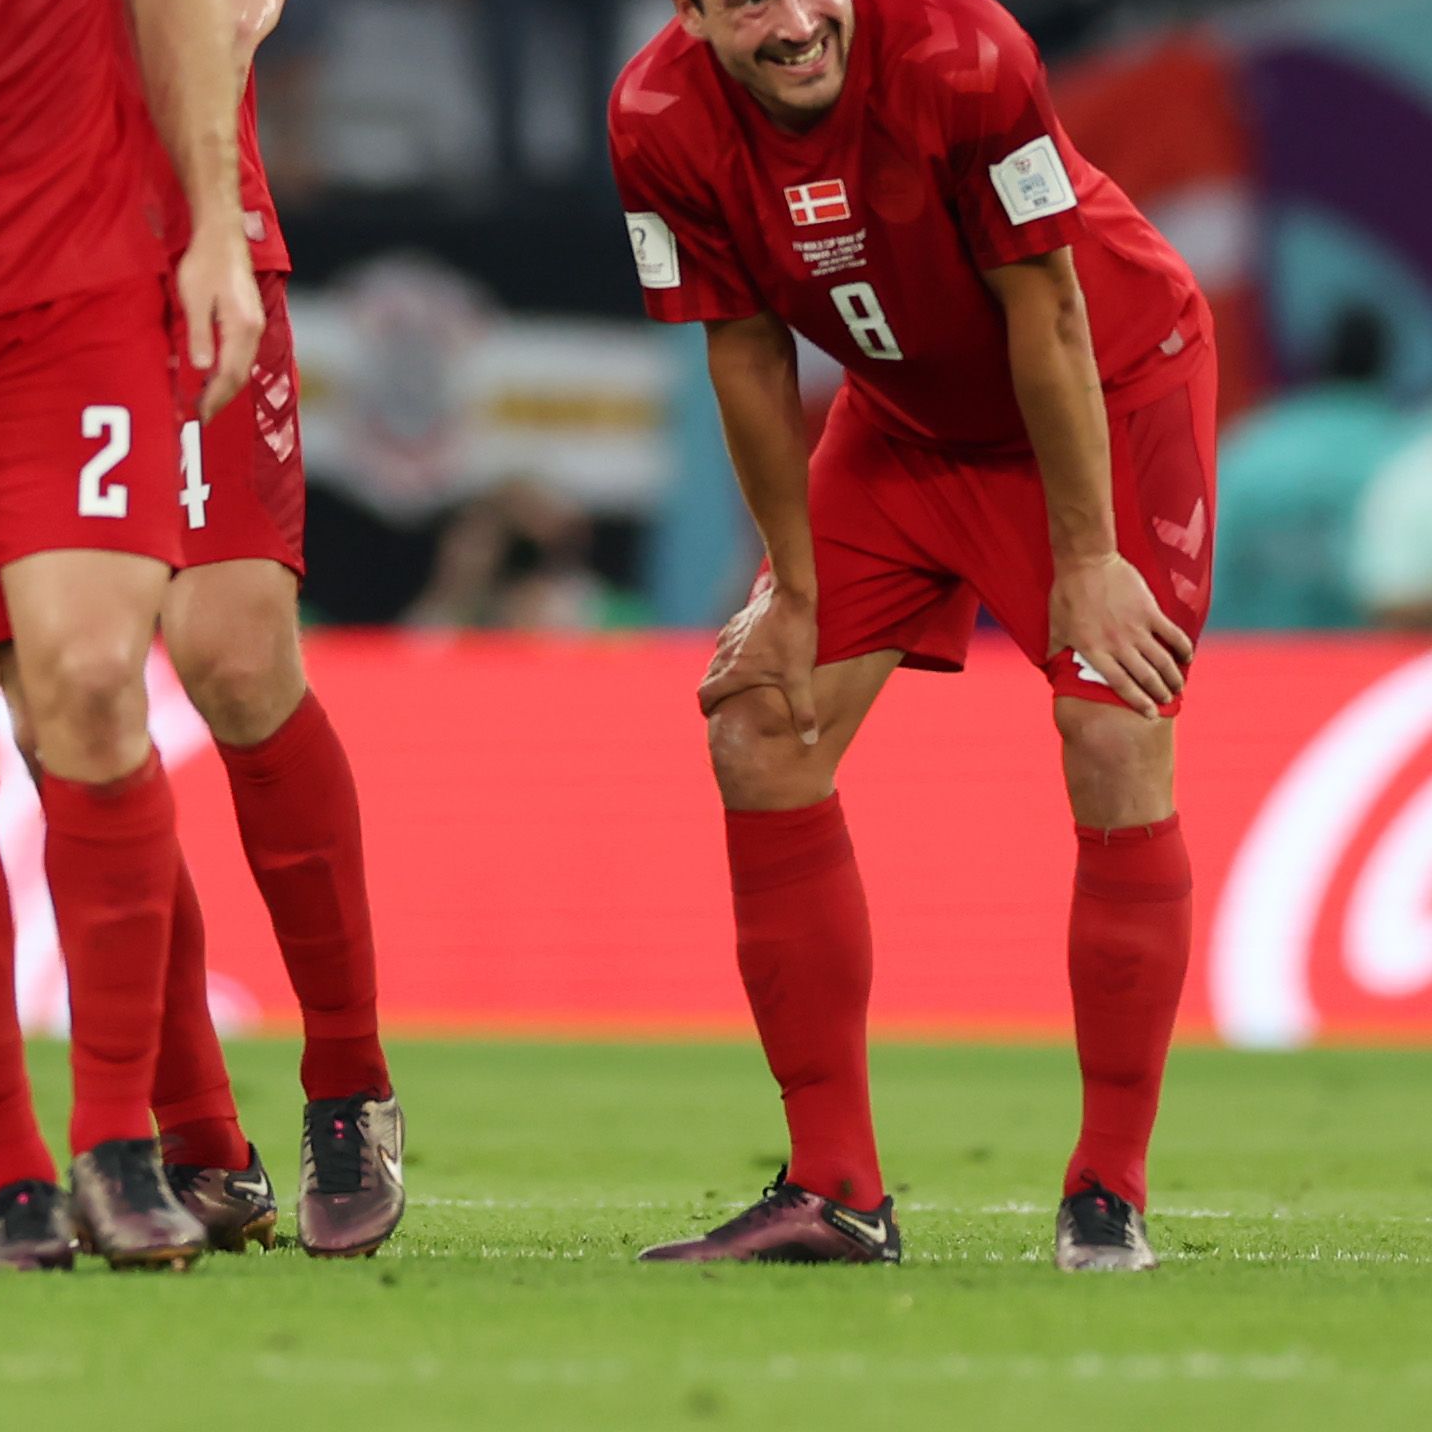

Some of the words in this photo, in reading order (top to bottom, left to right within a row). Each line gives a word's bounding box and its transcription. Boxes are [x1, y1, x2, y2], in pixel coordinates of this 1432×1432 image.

[829, 281, 904, 360] 8
[78, 405, 131, 518] 2
[179, 419, 211, 529] 4
